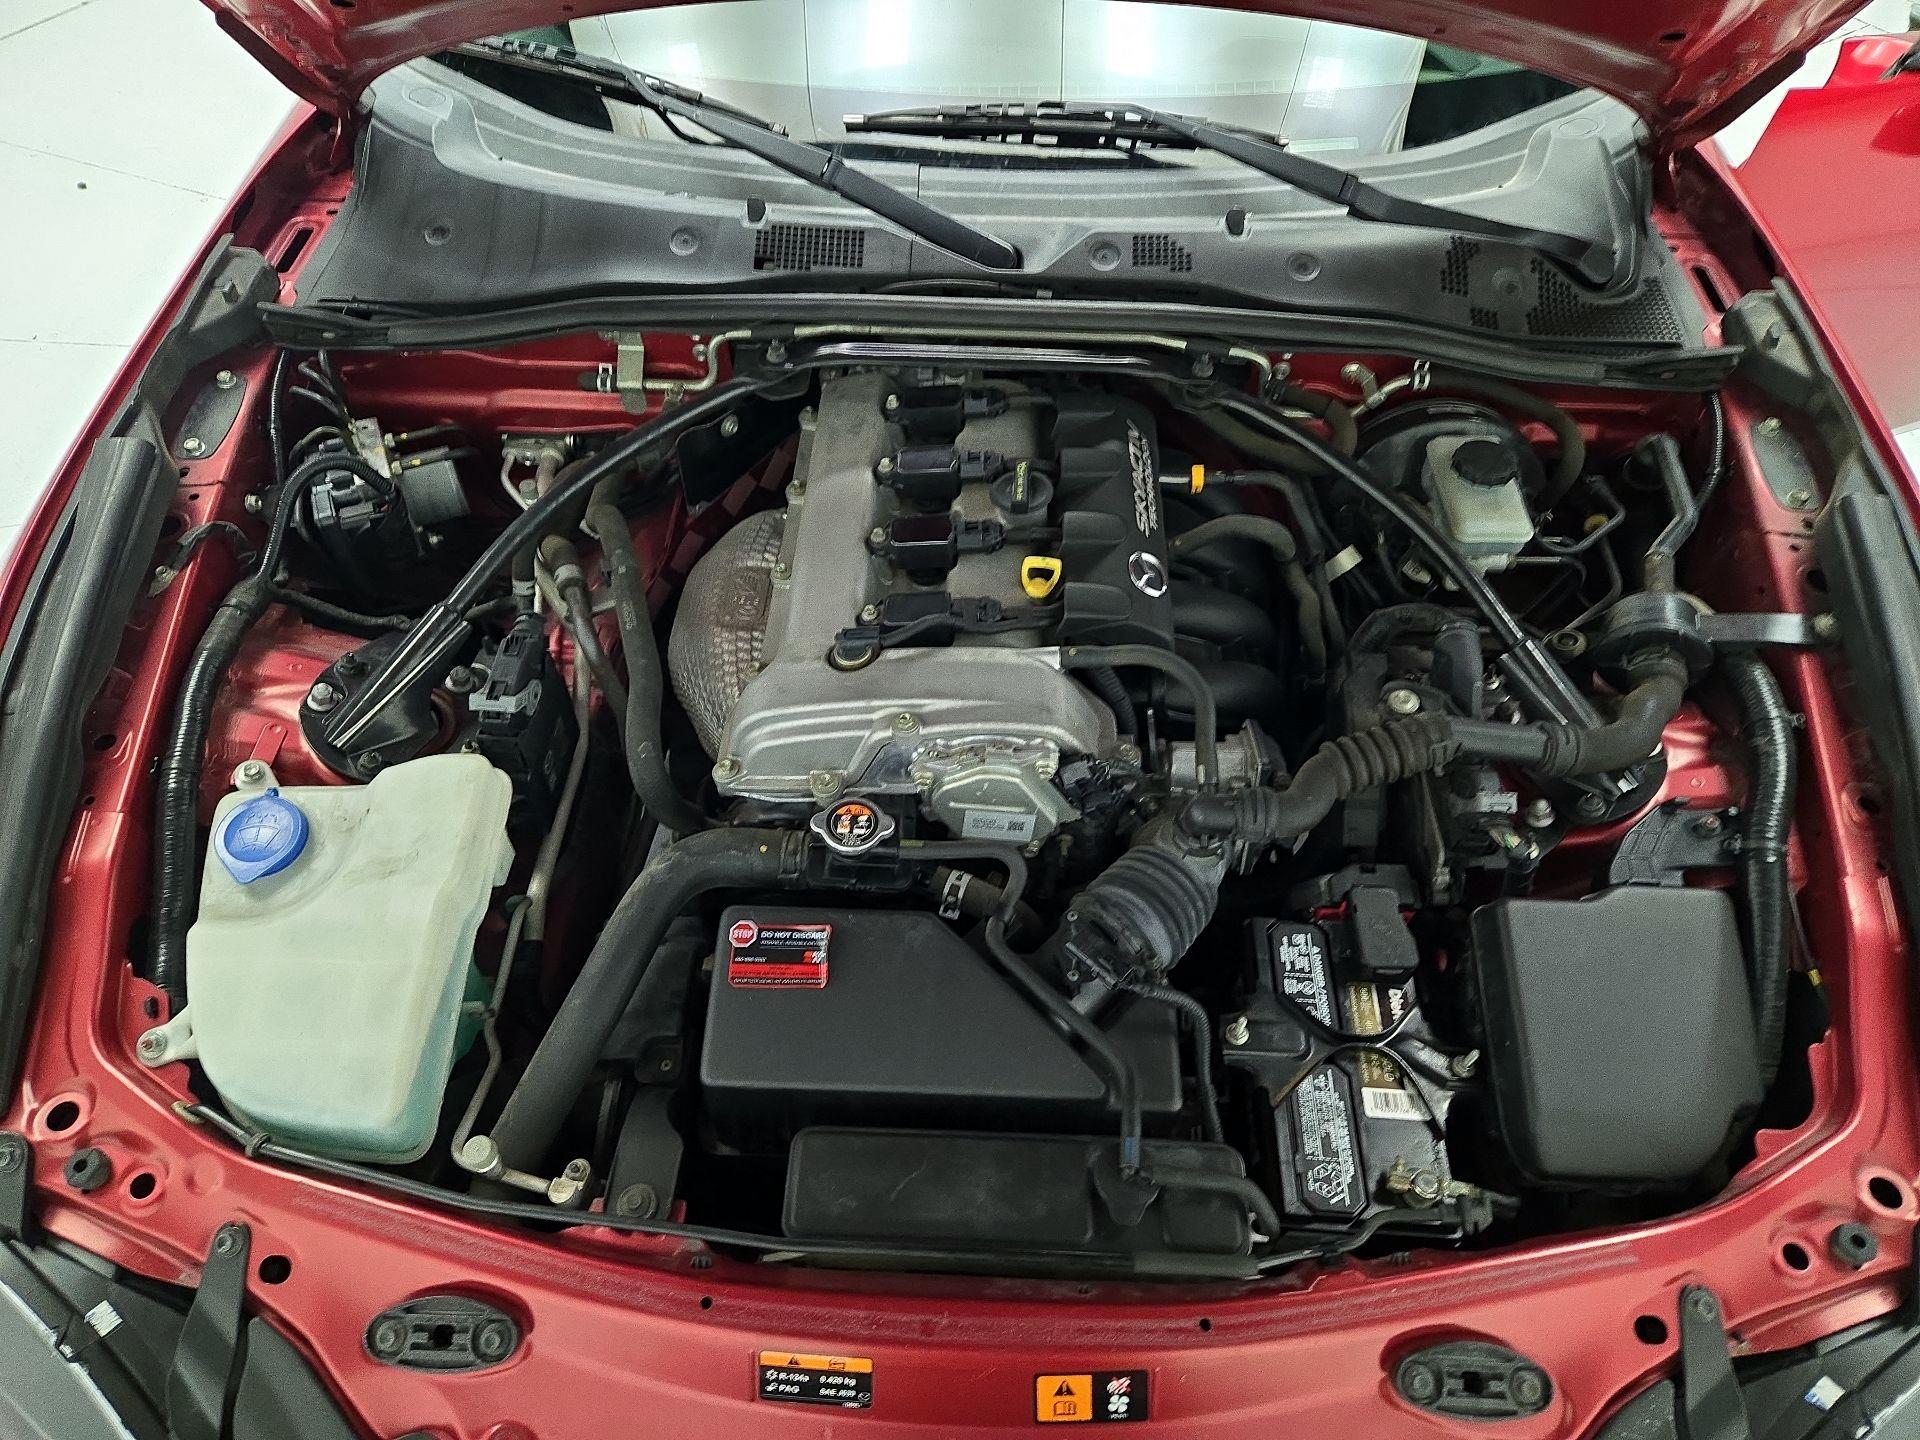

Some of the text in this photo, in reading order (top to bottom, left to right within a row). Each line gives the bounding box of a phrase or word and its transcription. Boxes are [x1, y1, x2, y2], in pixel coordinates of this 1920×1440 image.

[1127, 418, 1150, 538] SKYACTIV
[733, 930, 753, 939] STOP
[760, 931, 827, 940] DO NOT DISCARD
[779, 1372, 809, 1383] R-134a
[843, 1376, 857, 1387] kg
[778, 1384, 800, 1394] PAG
[819, 1388, 837, 1397] SAE
